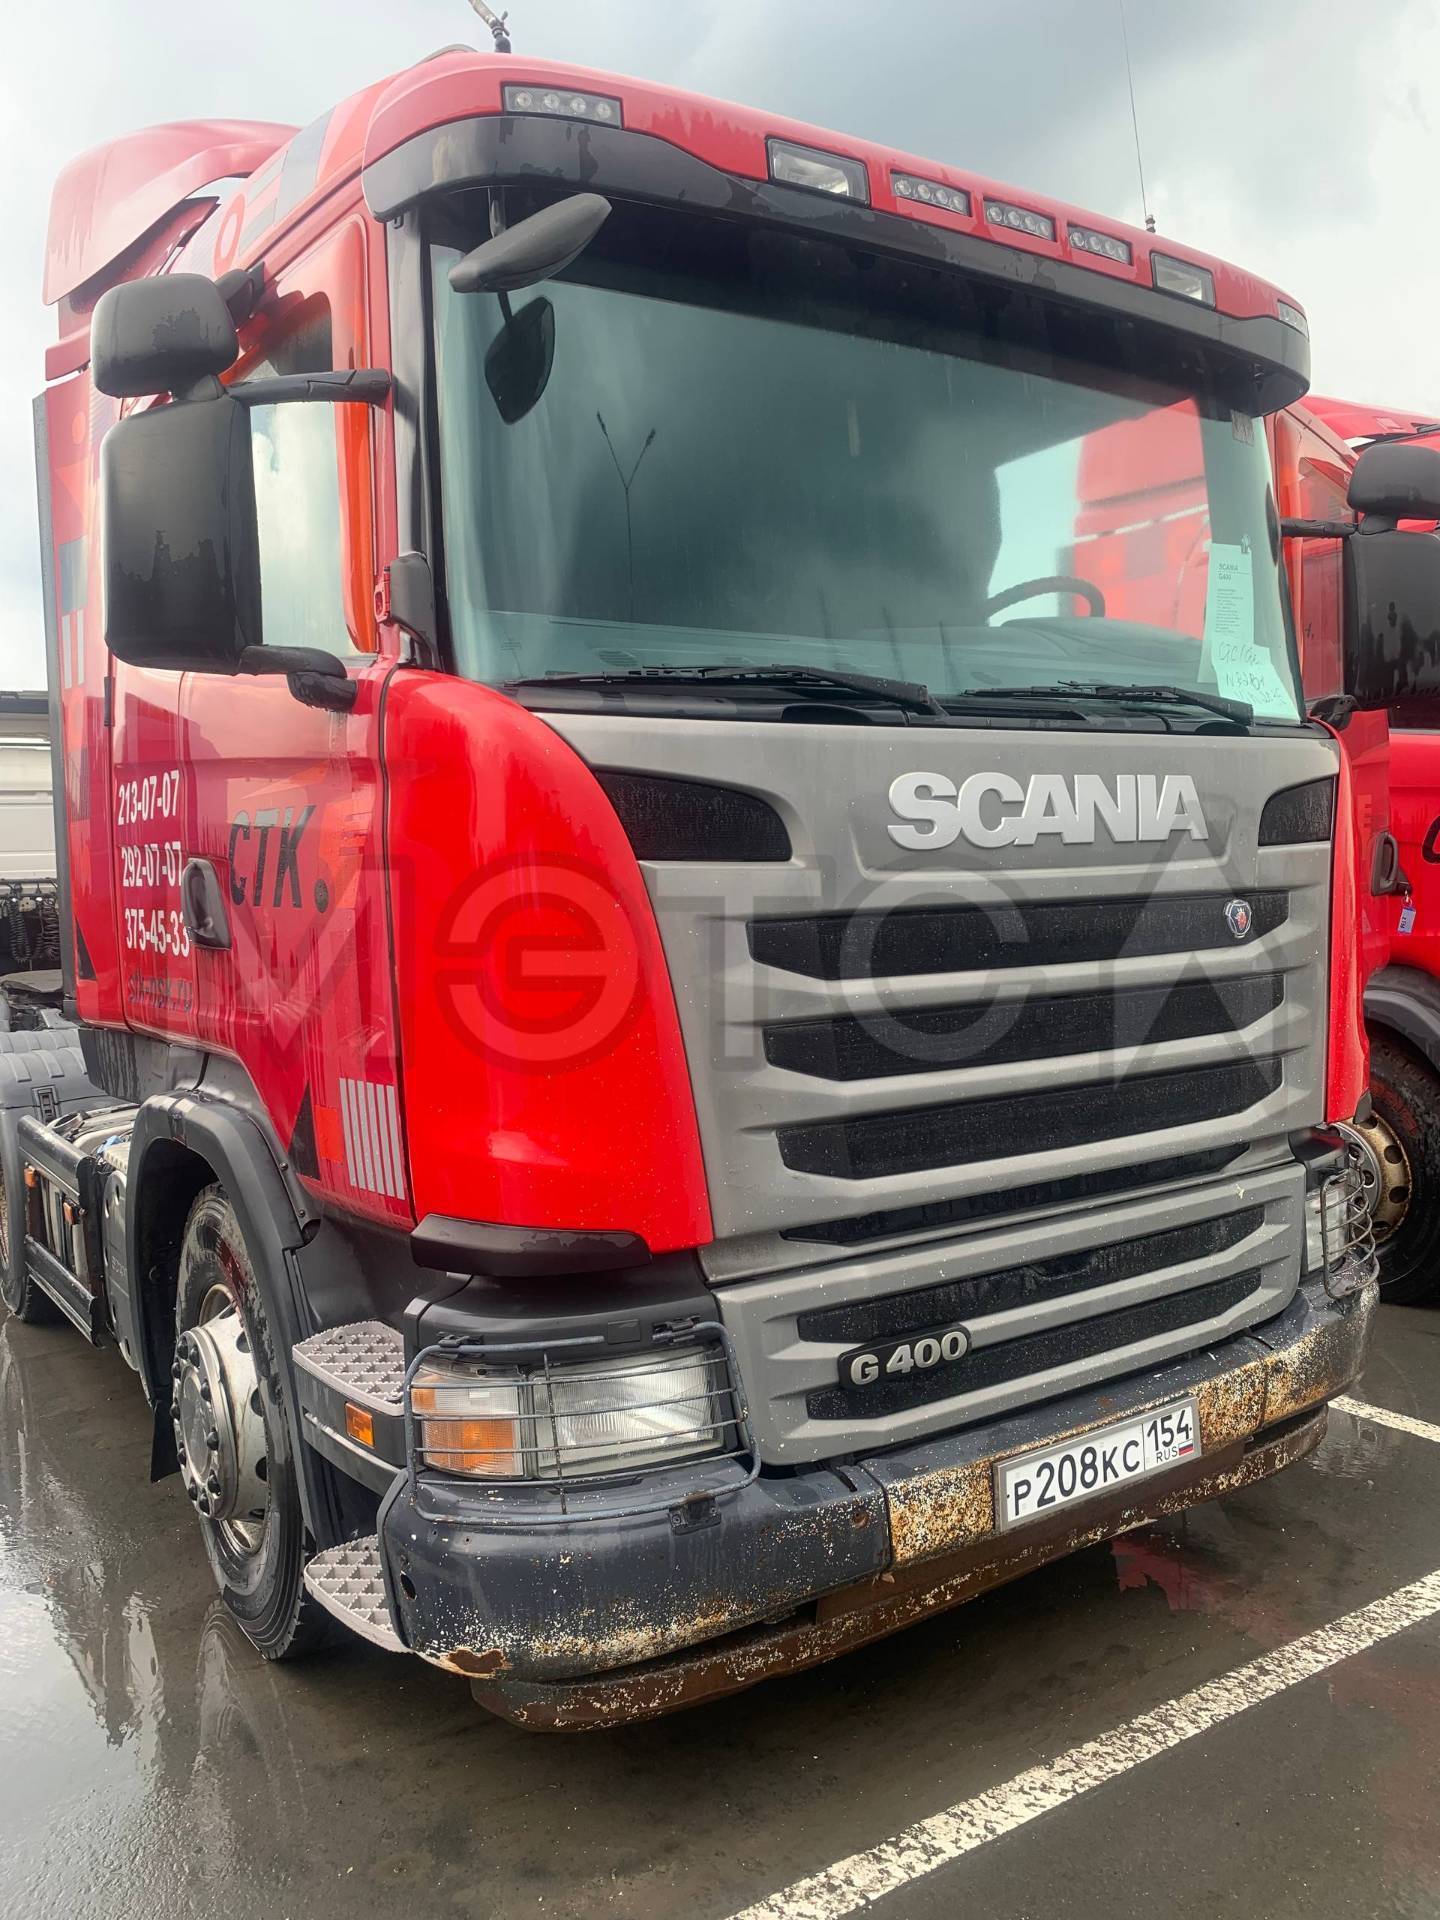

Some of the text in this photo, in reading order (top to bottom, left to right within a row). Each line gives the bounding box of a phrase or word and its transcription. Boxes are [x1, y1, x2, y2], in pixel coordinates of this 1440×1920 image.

[117, 769, 180, 826] 213-07-07
[886, 771, 1210, 851] SCANIA
[121, 841, 183, 888] 292-07-07
[124, 908, 190, 958] 375-45-33
[849, 1330, 969, 1386] G 400
[1147, 1409, 1191, 1451] 154
[1156, 1446, 1178, 1464] RUS
